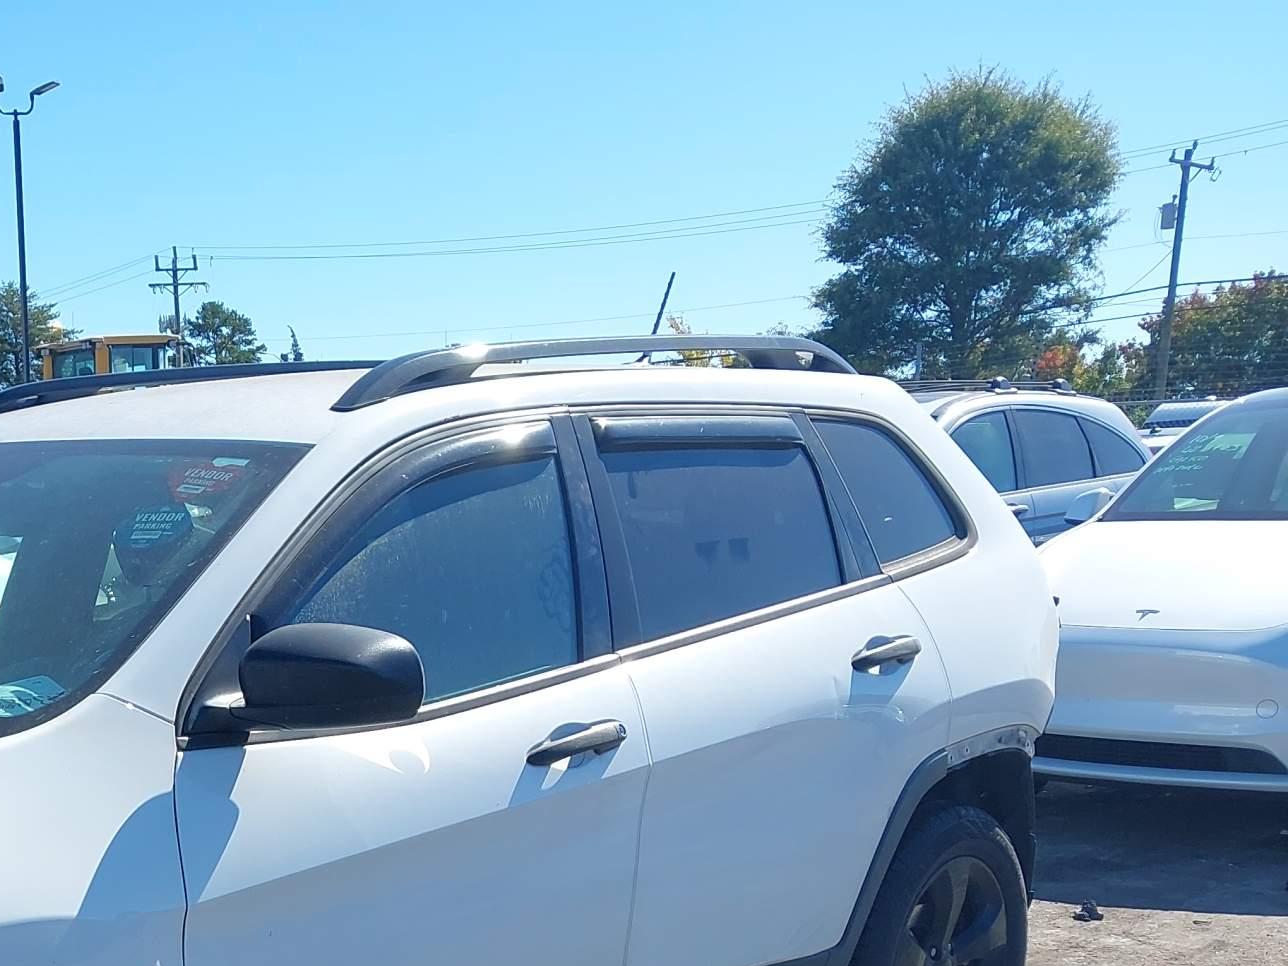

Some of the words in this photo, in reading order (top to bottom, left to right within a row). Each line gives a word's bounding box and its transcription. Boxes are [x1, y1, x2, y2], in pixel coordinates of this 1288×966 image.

[184, 467, 233, 481] VENDOR
[135, 512, 185, 522] VENDOR
[133, 522, 173, 530] PARKING
